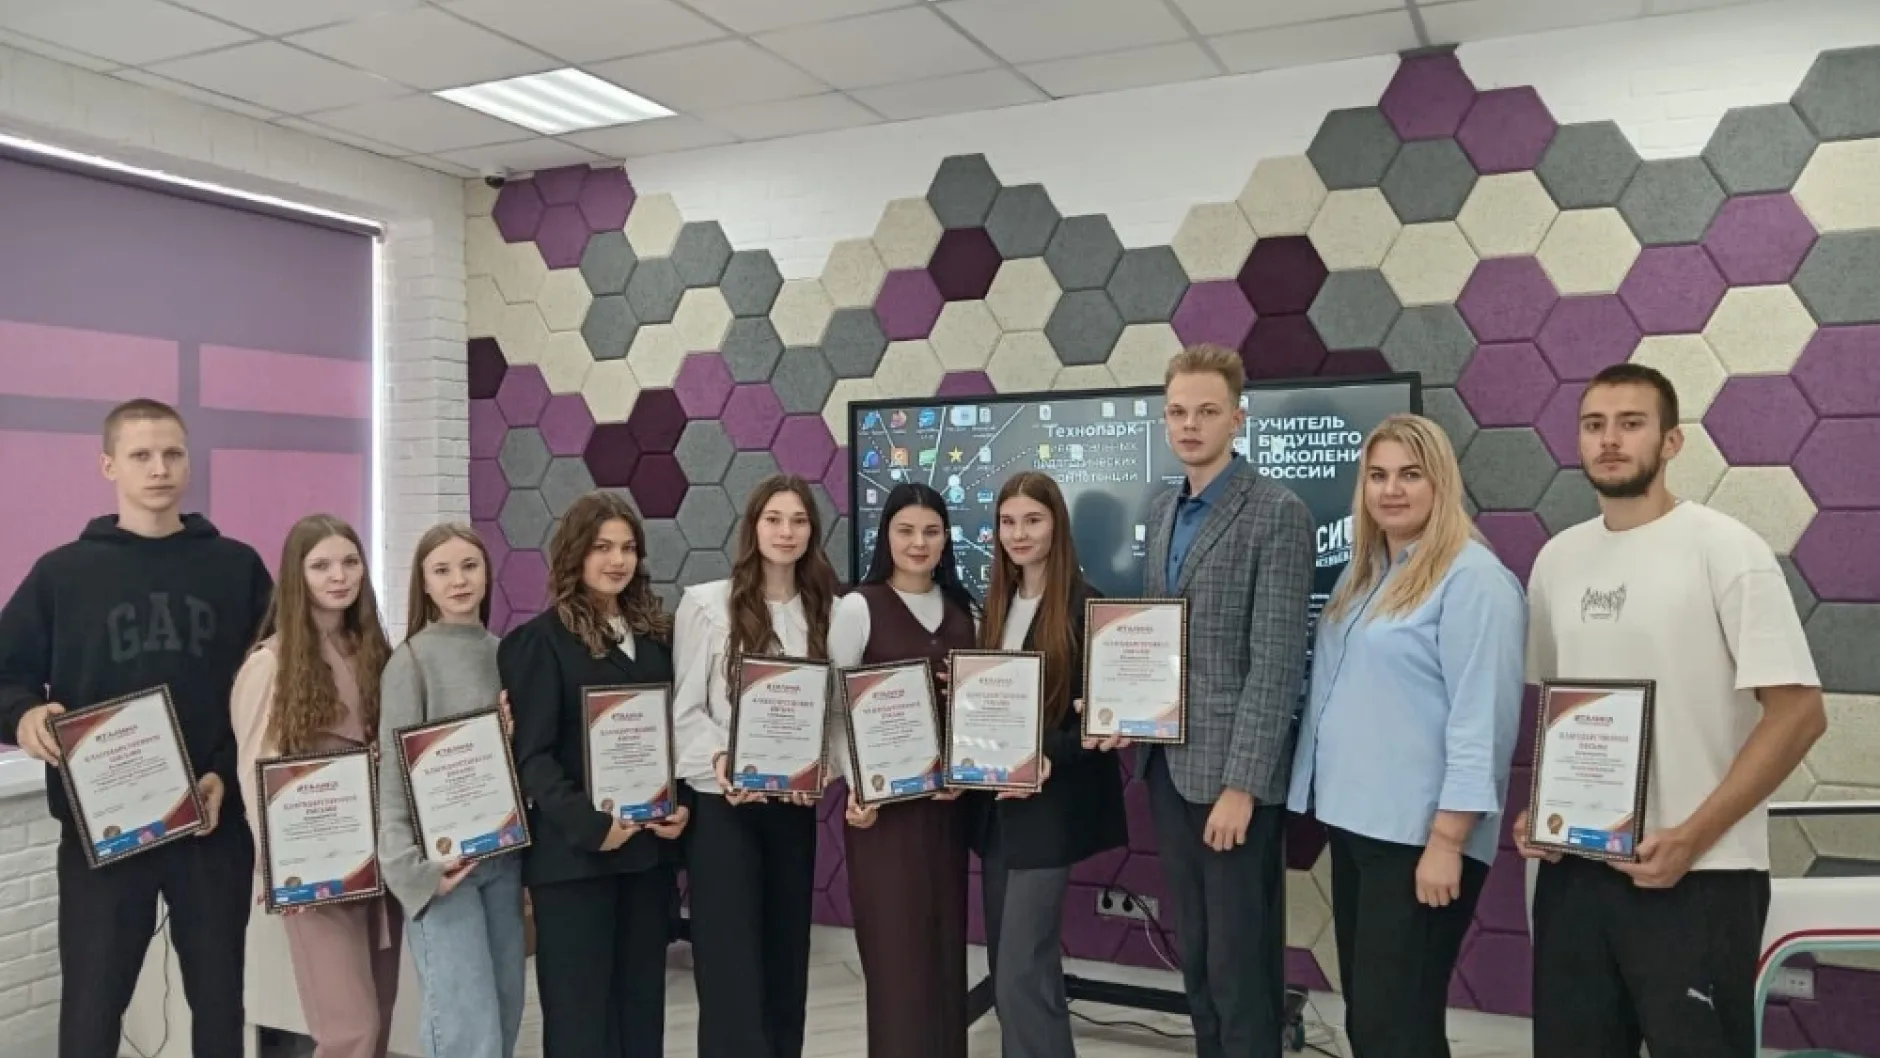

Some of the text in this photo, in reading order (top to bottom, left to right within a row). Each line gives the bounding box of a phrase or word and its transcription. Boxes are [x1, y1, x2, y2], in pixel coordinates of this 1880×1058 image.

[1045, 424, 1137, 437] Технопарк
[1259, 416, 1344, 431] УЧИТЕЛЬ
[1259, 449, 1361, 463] ПОКОЛЕНИ
[107, 592, 216, 663] GAP
